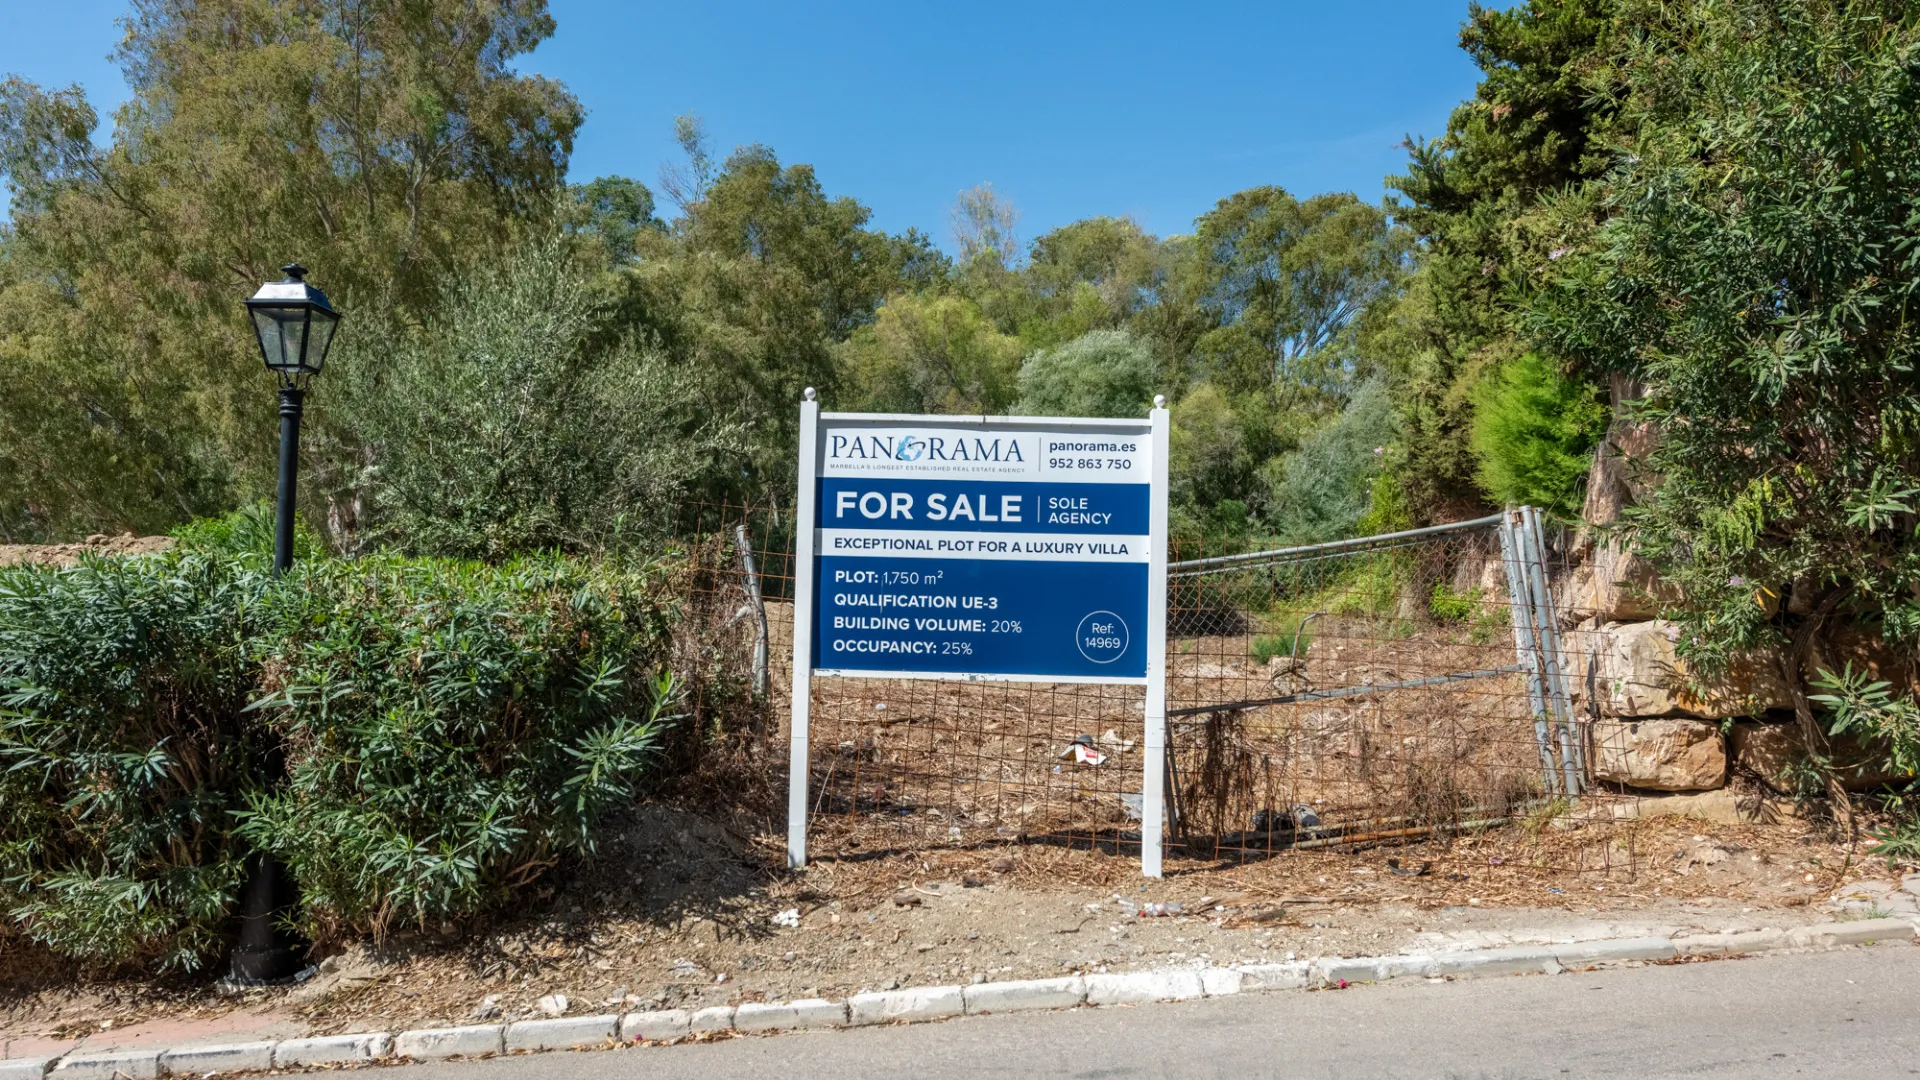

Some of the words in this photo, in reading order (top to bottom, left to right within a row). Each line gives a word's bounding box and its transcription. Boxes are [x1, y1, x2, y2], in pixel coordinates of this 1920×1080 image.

[1050, 441, 1136, 454] panorama.es
[1050, 458, 1073, 469] 952
[1078, 459, 1102, 469] 863
[1107, 459, 1131, 470] 750
[836, 492, 913, 519] FOR
[927, 494, 1022, 522] SALE
[1049, 498, 1088, 509] SOLE
[1049, 513, 1112, 524] AGENCY
[834, 538, 933, 551] EXCEPTIONAL
[938, 540, 974, 552] PLOT
[978, 541, 1007, 552] FOR
[1011, 542, 1021, 552] A
[1026, 542, 1083, 554] LUXURY
[1088, 544, 1128, 555] VILLA
[835, 571, 878, 583] PLOT:
[883, 572, 919, 585] 1,750
[924, 571, 943, 584] m²
[834, 594, 956, 608] QUALIFICATION
[962, 597, 998, 609] UE-3
[834, 617, 910, 630] BUILDING
[915, 619, 986, 632] VOLUME:
[991, 620, 1022, 633] 20%
[1092, 623, 1114, 634] Ref:
[833, 640, 936, 654] OCCUPANCY:
[942, 642, 973, 655] 25%
[1085, 638, 1120, 648] 14969
